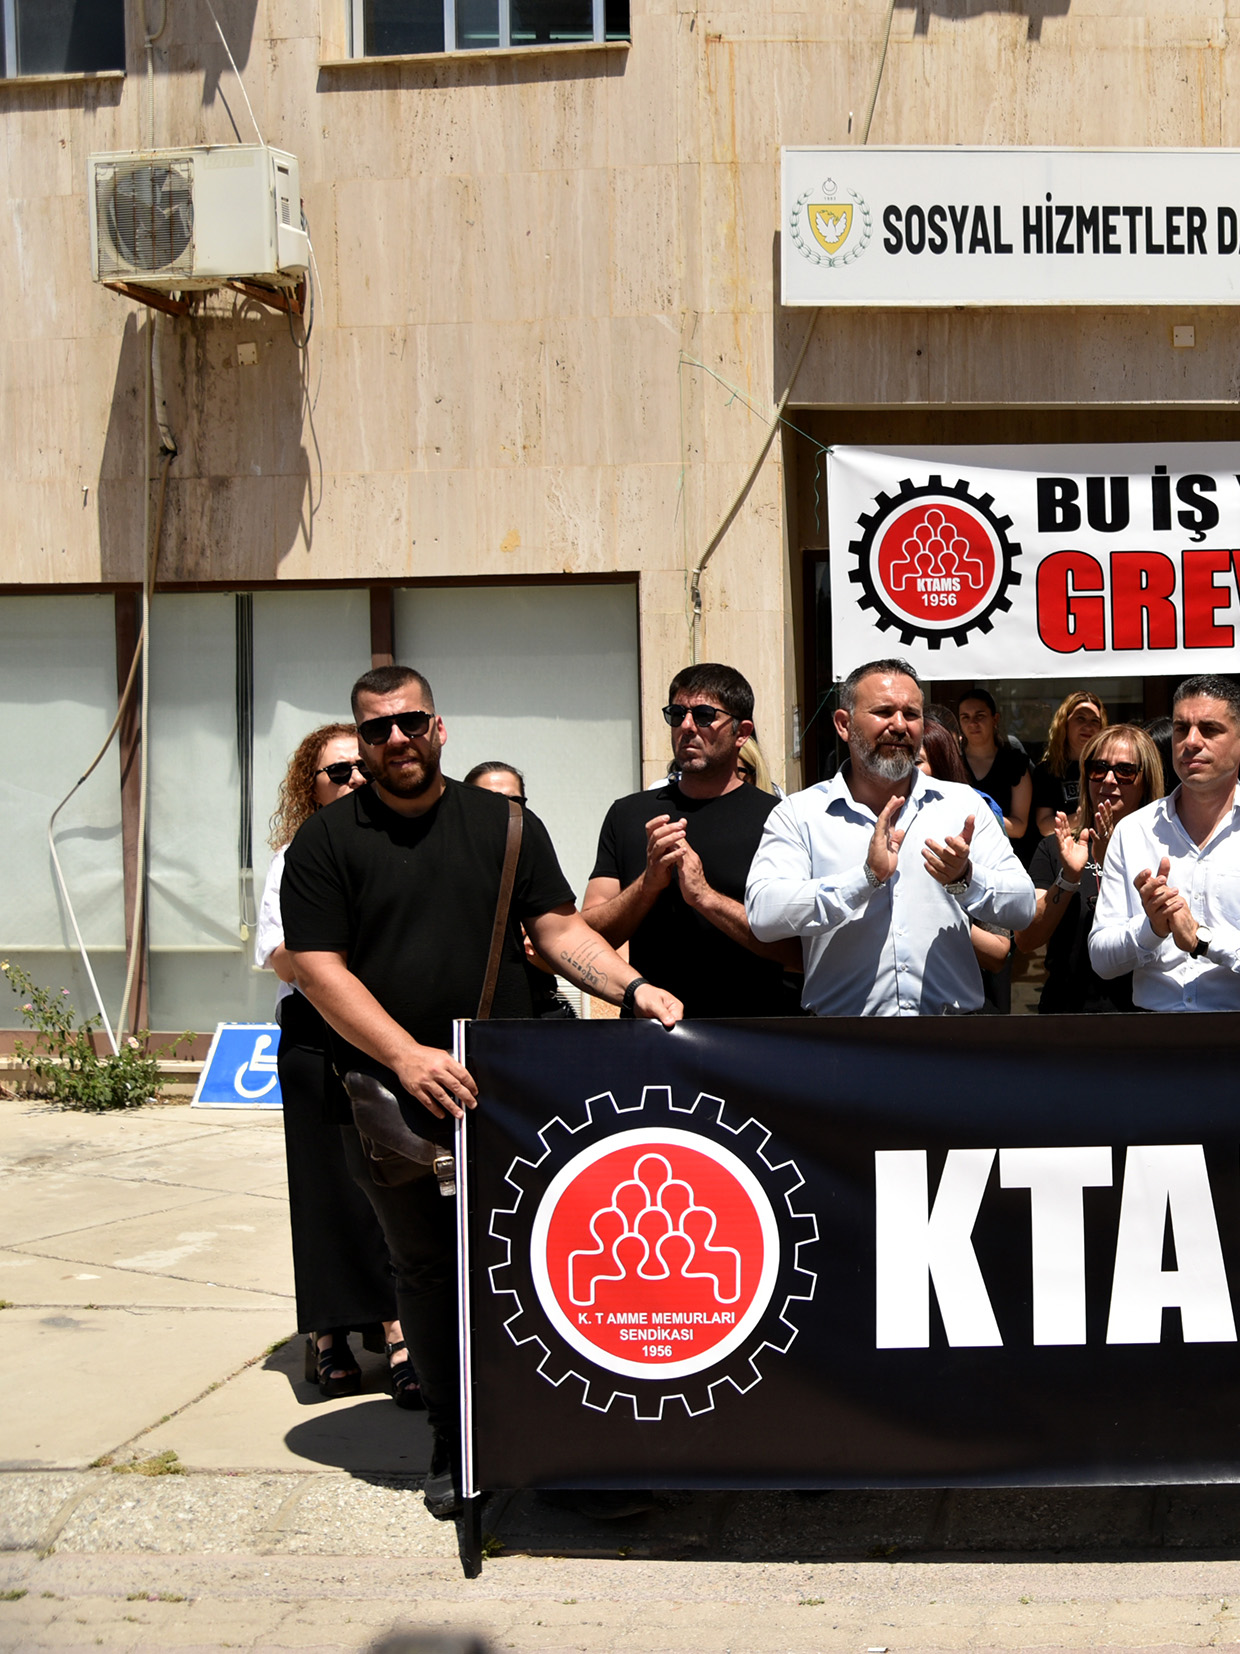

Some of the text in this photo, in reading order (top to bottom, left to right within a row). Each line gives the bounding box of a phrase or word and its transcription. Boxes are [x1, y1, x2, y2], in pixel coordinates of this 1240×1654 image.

[882, 204, 1014, 255] SOSYAL
[1022, 192, 1208, 255] HİZMETLER
[1036, 476, 1130, 533] BU
[1151, 464, 1220, 543] İŞ
[916, 577, 961, 592] KTAMS
[921, 593, 957, 607] 1956
[578, 1311, 735, 1325] K. T AMME MEMURLARI
[619, 1326, 694, 1341] SENDİKASI
[642, 1345, 673, 1357] 1956
